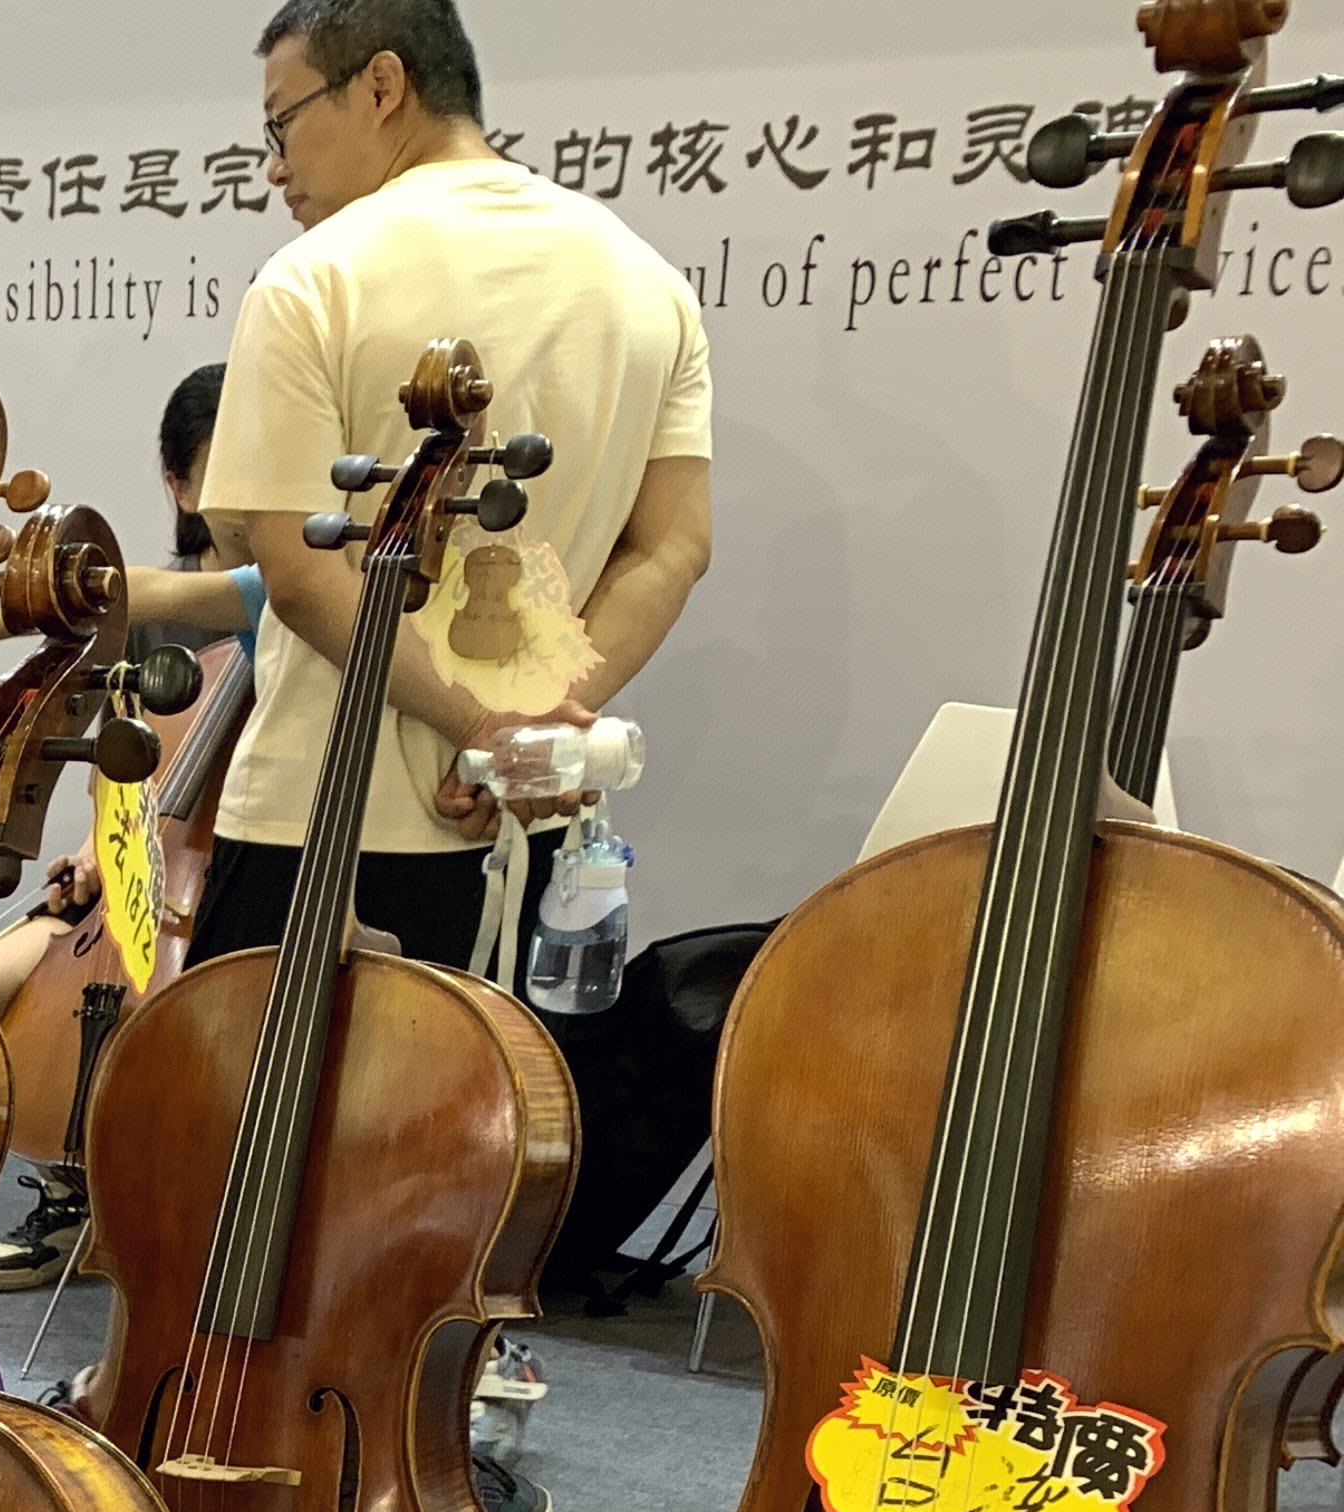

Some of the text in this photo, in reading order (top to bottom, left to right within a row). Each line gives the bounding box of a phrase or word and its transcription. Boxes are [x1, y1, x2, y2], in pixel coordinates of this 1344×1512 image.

[185, 255, 220, 319] is
[760, 234, 826, 308] of
[843, 228, 1069, 331] perfect
[871, 1377, 923, 1409] 原價
[965, 1380, 1153, 1501] 特價
